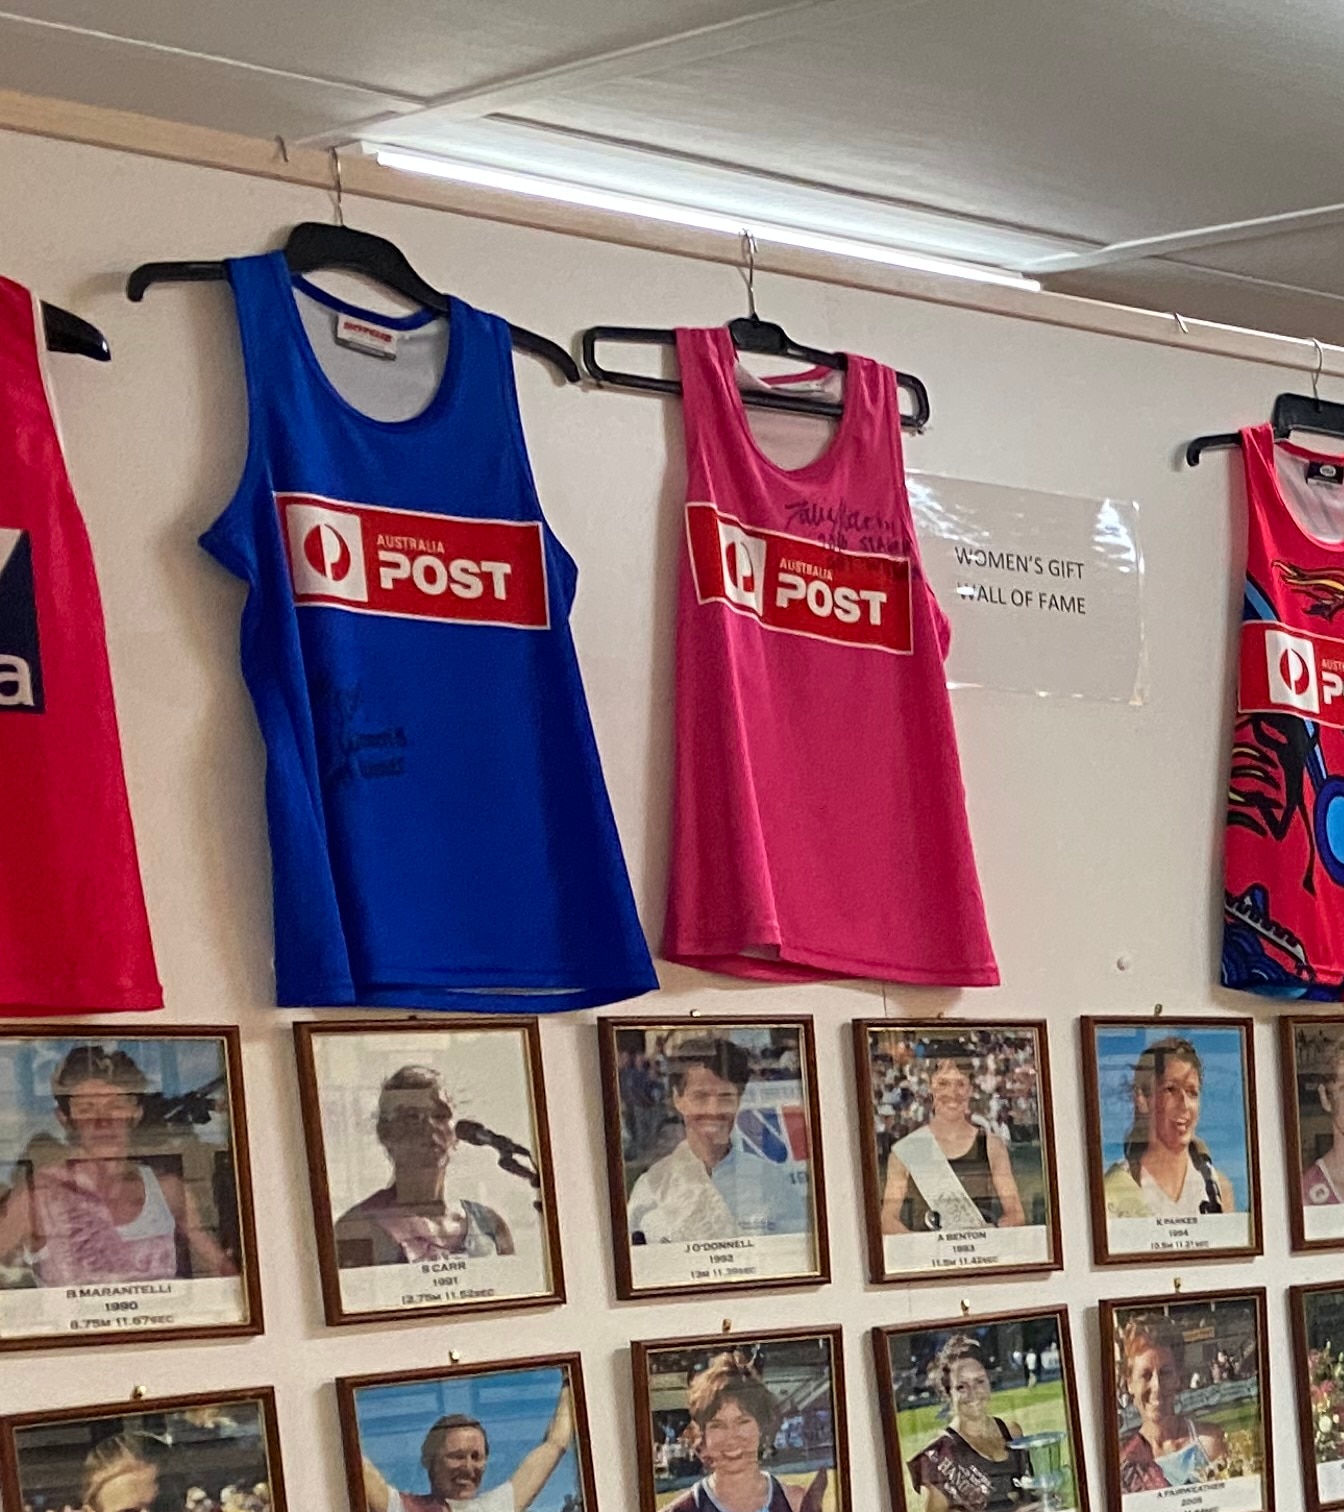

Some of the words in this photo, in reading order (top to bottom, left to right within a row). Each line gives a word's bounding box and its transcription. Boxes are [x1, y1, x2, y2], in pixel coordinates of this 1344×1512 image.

[376, 532, 446, 554] AUSTRALIA
[378, 549, 513, 601] POST
[779, 557, 834, 581] AUSTRALIA
[953, 545, 1044, 575] WOMEN'S
[1048, 558, 1085, 580] GIFT
[775, 572, 888, 626] POST
[1010, 589, 1034, 608] OF
[1038, 594, 1087, 615] FAME
[432, 1260, 467, 1273] CARR
